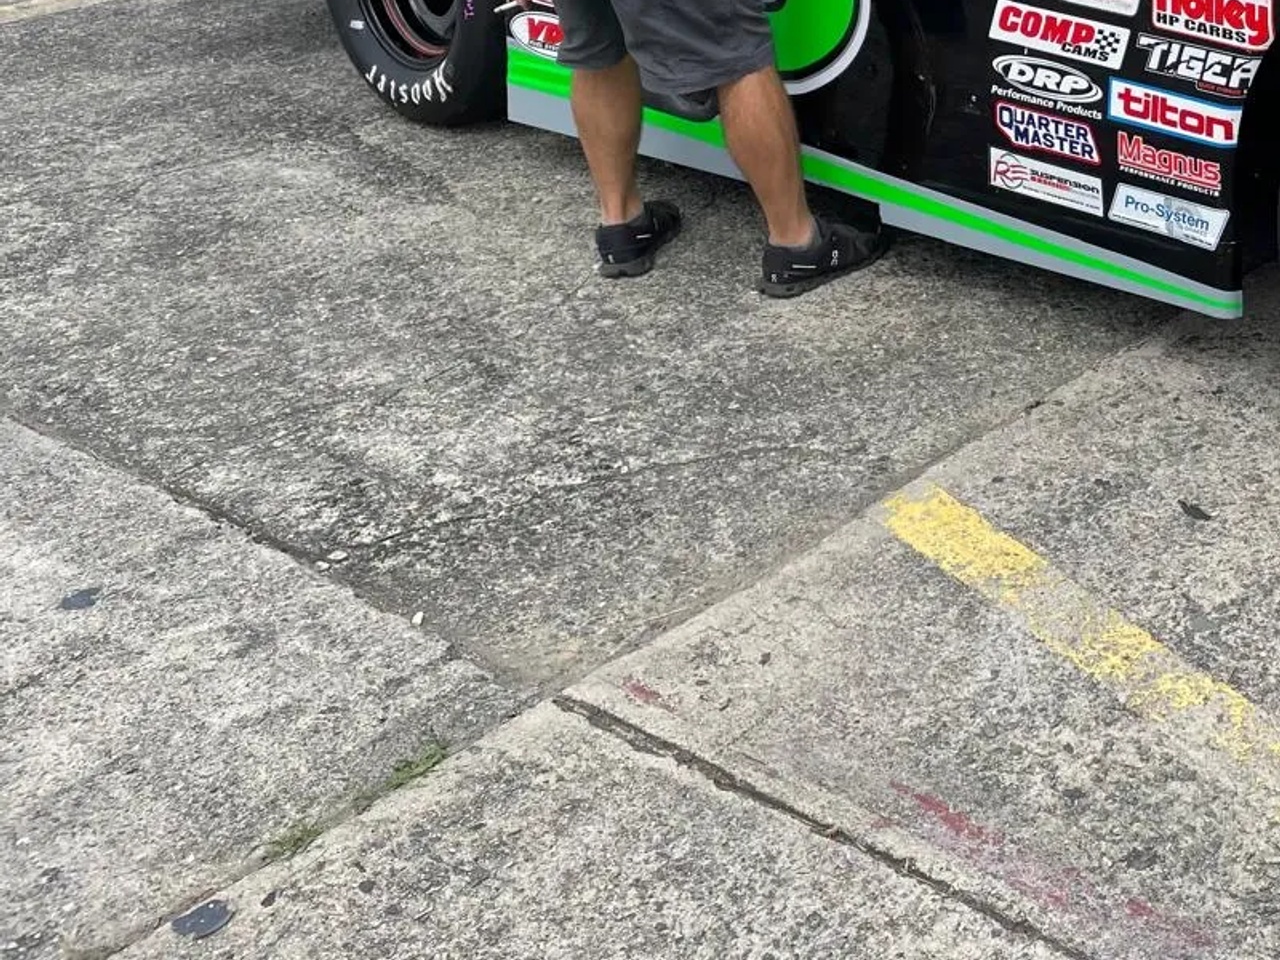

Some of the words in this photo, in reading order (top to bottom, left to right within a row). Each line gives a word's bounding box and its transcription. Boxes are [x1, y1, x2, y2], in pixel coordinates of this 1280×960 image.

[998, 5, 1096, 46] COMP
[1156, 12, 1183, 27] HP
[1184, 20, 1247, 43] CARBS
[1061, 42, 1110, 62] CAMS
[1007, 61, 1090, 94] DRP
[991, 84, 1054, 108] Performance
[1056, 101, 1102, 120] Products
[1118, 88, 1234, 141] tilton
[999, 105, 1088, 142] QUARTER
[1014, 125, 1094, 160] MASTER
[1118, 131, 1222, 187] Magnus
[1119, 165, 1175, 186] PERFORMANCE
[1177, 181, 1221, 197] PRODUCTS
[1124, 195, 1210, 231] Pro-System
